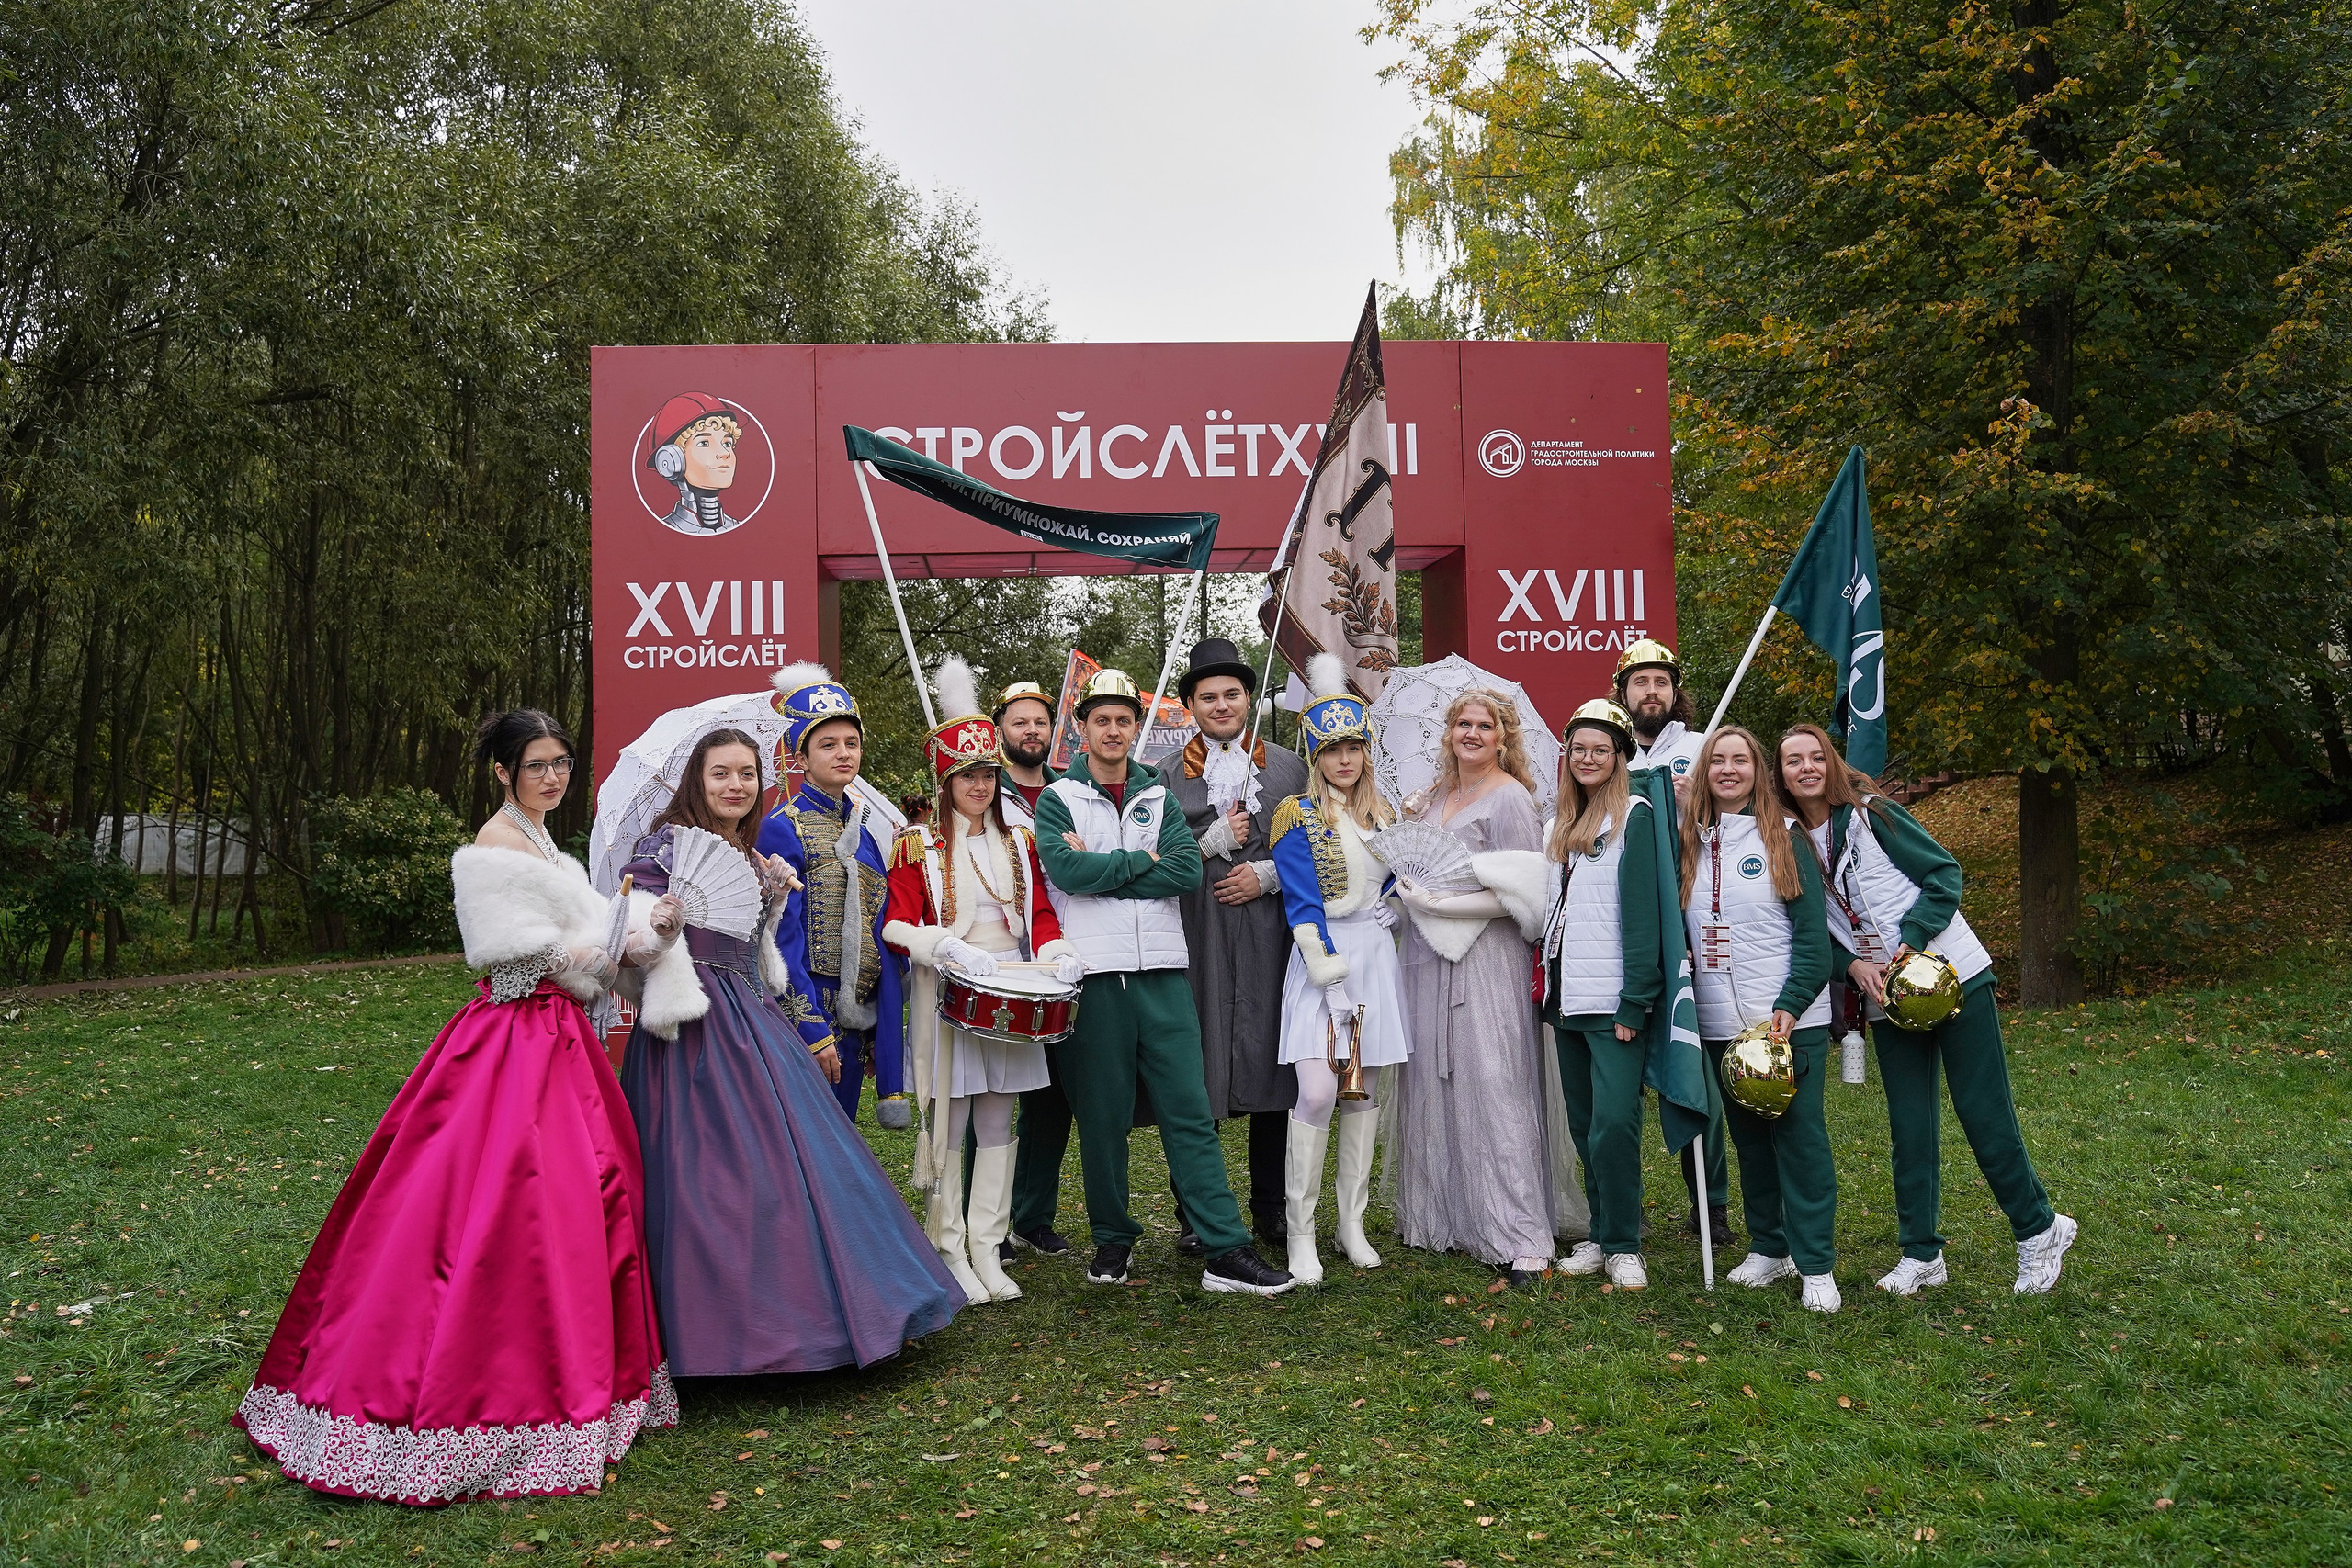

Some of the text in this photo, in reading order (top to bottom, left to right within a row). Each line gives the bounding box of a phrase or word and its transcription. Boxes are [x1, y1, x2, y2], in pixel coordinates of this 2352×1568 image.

[1531, 449, 1655, 458] ГРАДОСТРОИТЕЛЬНОЙ ПОЛИТИКИ
[1531, 458, 1599, 467] ГОРОДА МОСКВЫ
[971, 488, 1094, 542] ПРИУМНОЖАЙ.
[625, 581, 784, 637] XVIII
[1497, 569, 1645, 622] XVIII
[1497, 625, 1647, 652] СТРОЙСЛЁТ
[624, 638, 787, 669] СТРОЙСЛЁТ
[1134, 811, 1150, 819] BMS
[1743, 863, 1761, 871] BMS
